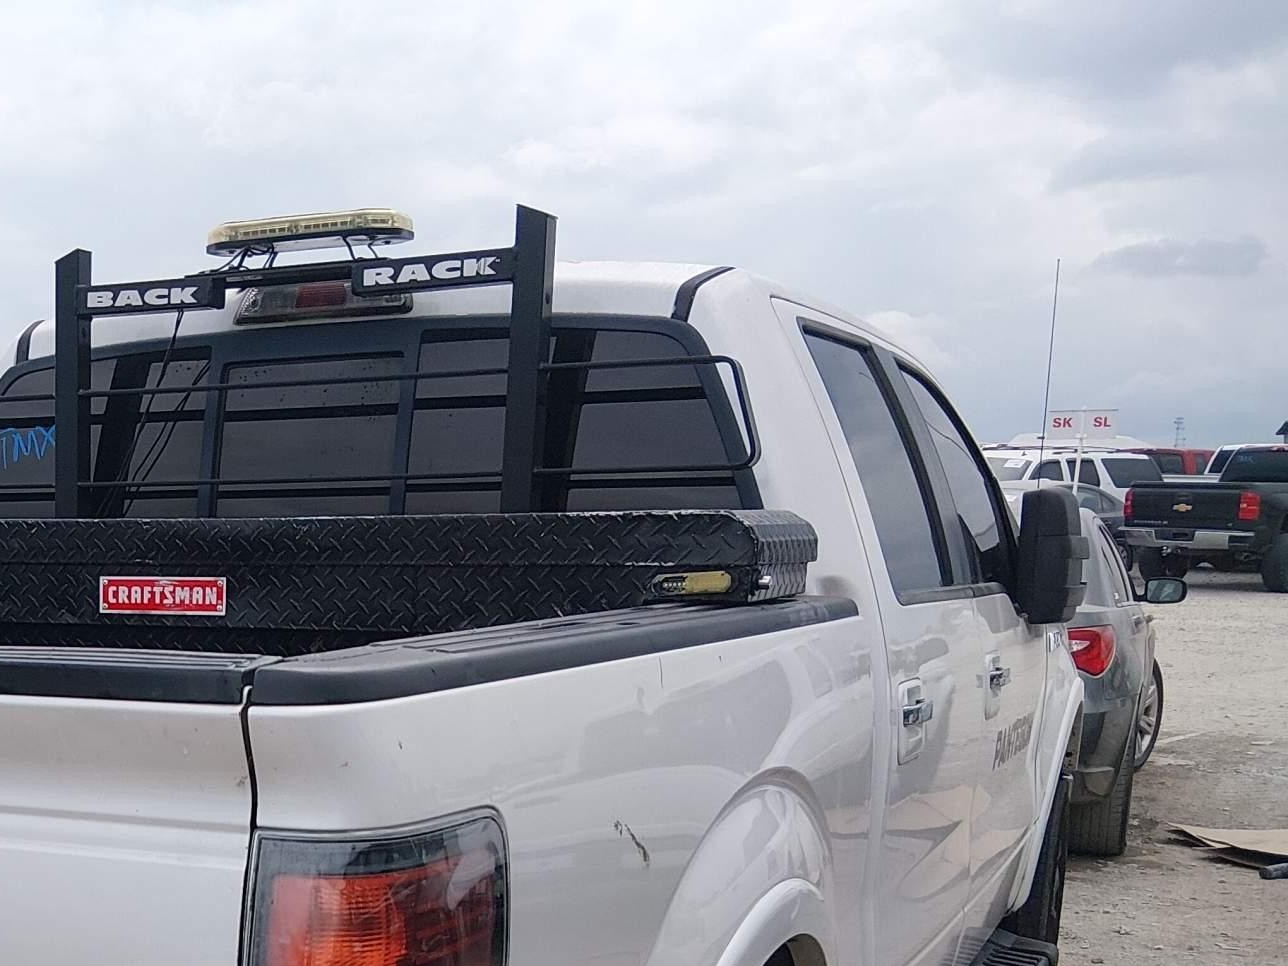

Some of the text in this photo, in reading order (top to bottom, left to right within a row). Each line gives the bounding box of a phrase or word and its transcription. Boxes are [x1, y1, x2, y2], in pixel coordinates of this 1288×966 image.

[87, 257, 497, 308] BACK RACK
[1052, 417, 1073, 428] SK
[1093, 416, 1112, 428] SL
[108, 585, 219, 606] CRAFTSMAN
